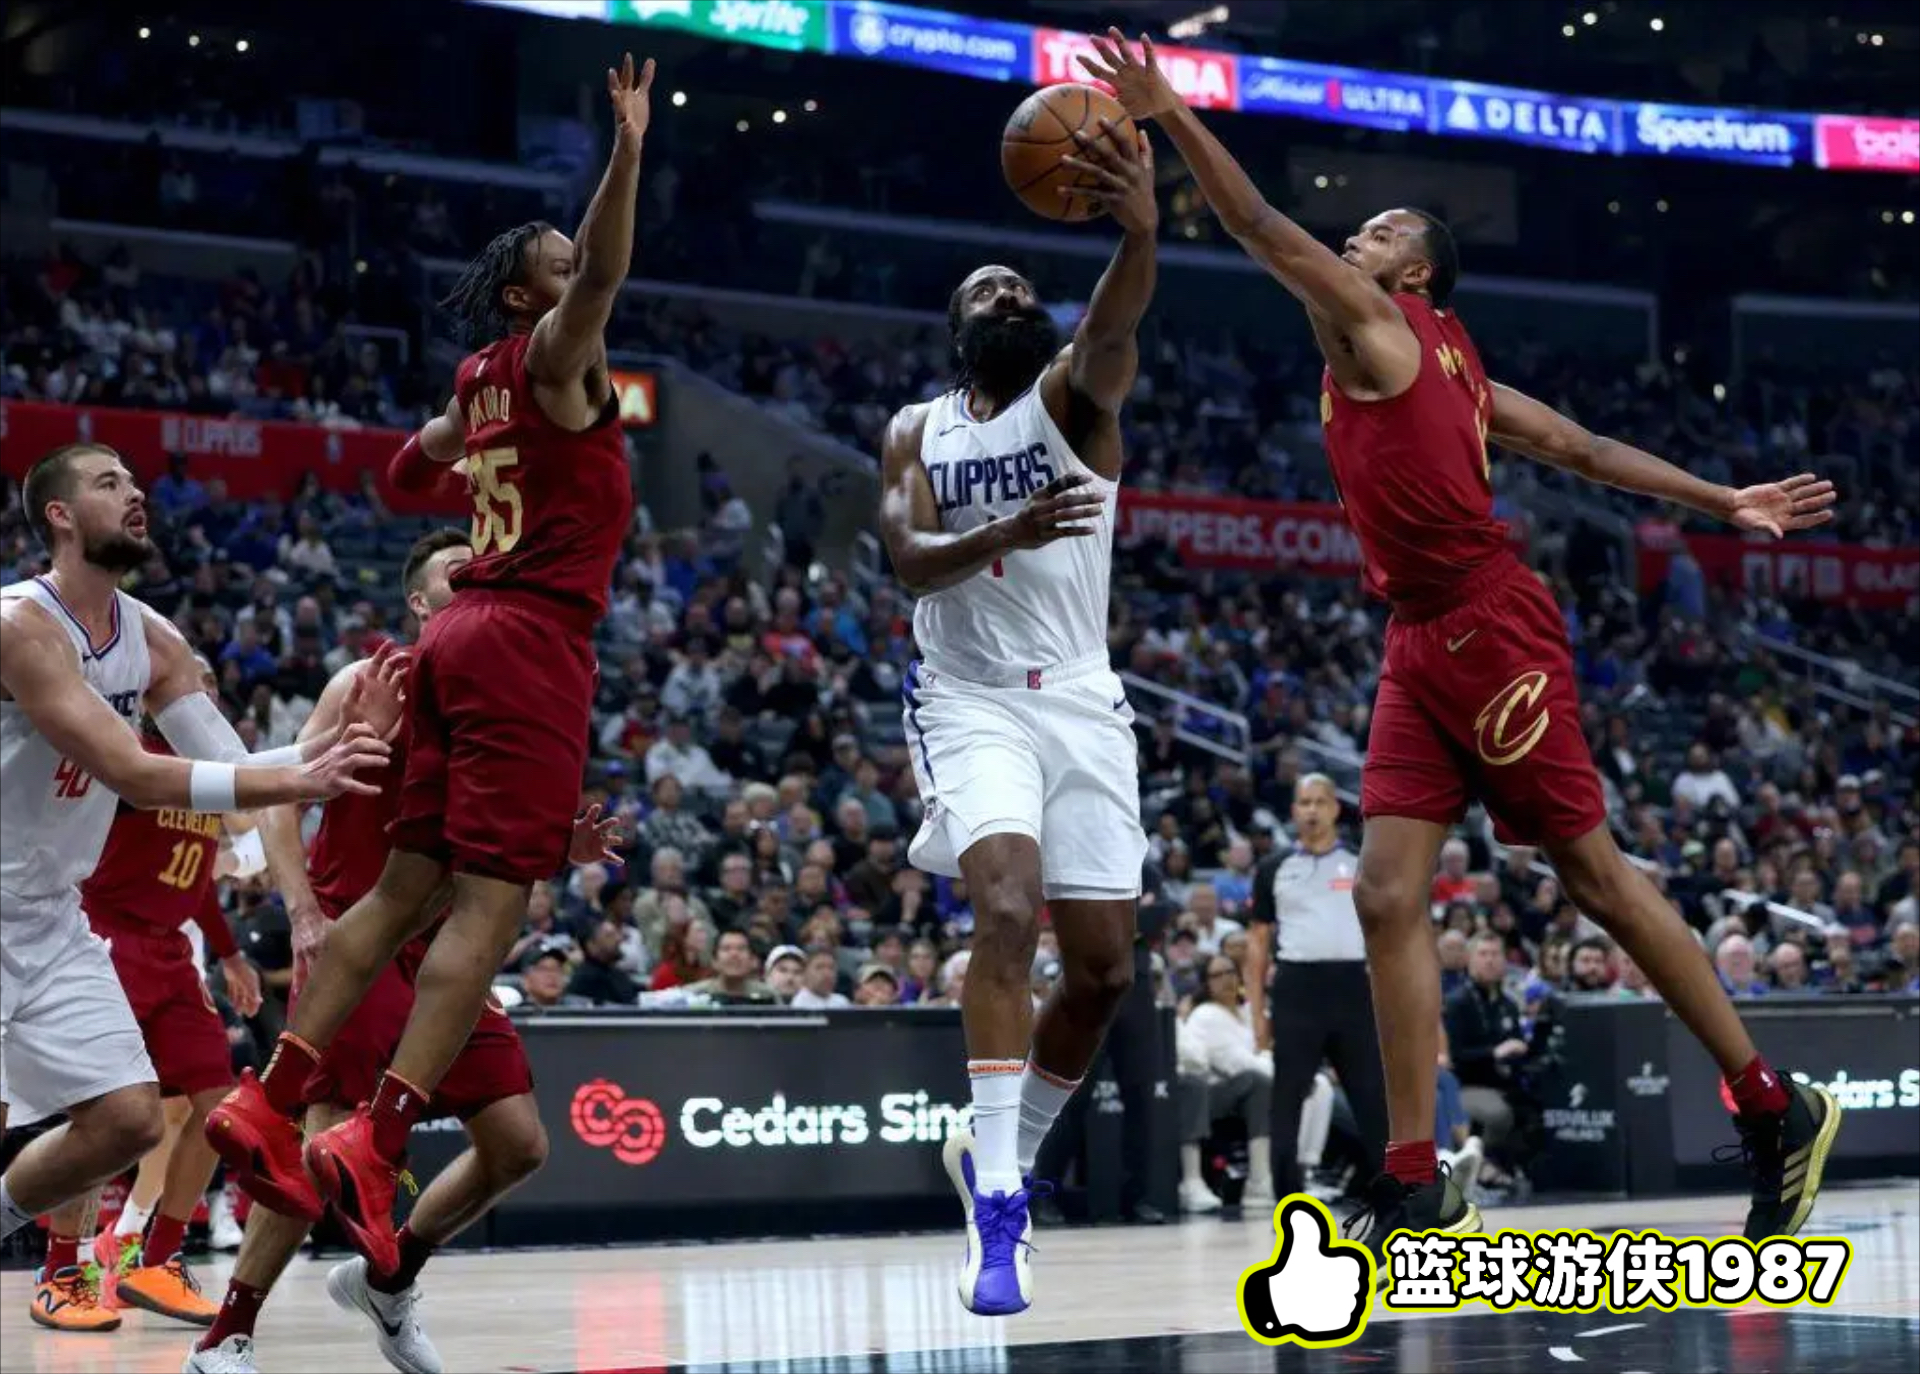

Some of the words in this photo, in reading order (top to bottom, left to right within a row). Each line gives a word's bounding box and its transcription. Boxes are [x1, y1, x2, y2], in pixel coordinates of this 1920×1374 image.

[887, 23, 1016, 62] crypto.com
[1343, 83, 1425, 118] ULTRA
[1486, 100, 1606, 143] DELTA
[1636, 103, 1791, 153] Spectrum
[469, 446, 523, 556] 35
[927, 441, 1054, 511] CLIPPERS
[157, 838, 204, 891] 10
[680, 1090, 869, 1148] Cedars
